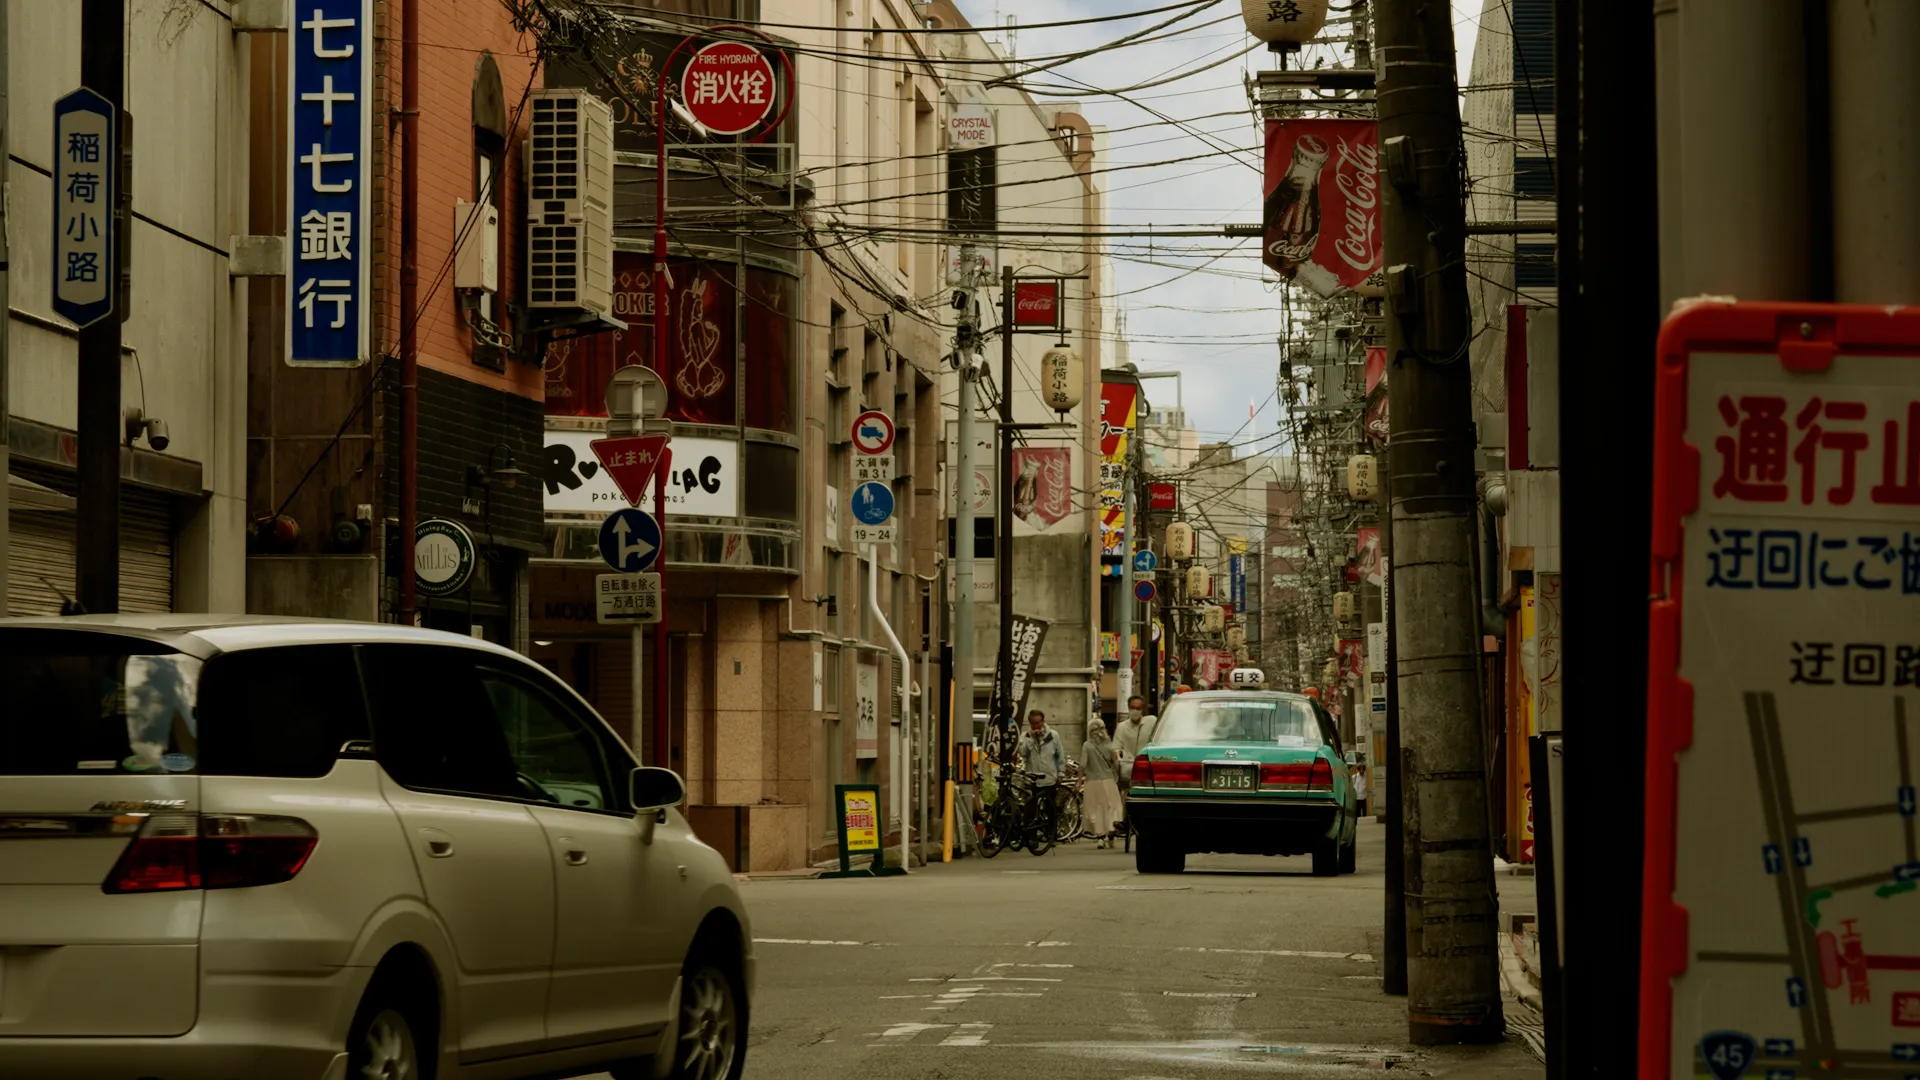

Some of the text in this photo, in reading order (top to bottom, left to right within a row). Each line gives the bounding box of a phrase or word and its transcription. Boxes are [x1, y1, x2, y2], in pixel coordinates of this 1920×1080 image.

[699, 53, 758, 65] FIRE HYDRANT
[692, 69, 766, 105] 消火栓
[951, 117, 991, 129] CRYSTAL
[957, 129, 985, 140] MODE
[299, 9, 356, 328] 七十七銀行
[65, 131, 100, 284] 稲荷小路
[1334, 134, 1378, 271] Coca-Cola
[1018, 298, 1052, 311] Coca-Cola
[1051, 355, 1069, 403] 稲荷小路
[609, 449, 654, 468] 止まれ
[855, 457, 890, 468] 大貨等
[1044, 455, 1065, 517] Coca-Cola
[855, 529, 890, 540] 19-24
[601, 578, 656, 592] 自転車を除く
[602, 595, 656, 608] 一方通行路
[1234, 672, 1260, 683] 日交
[1219, 775, 1251, 788] 31-15
[1711, 1043, 1744, 1068] 45
